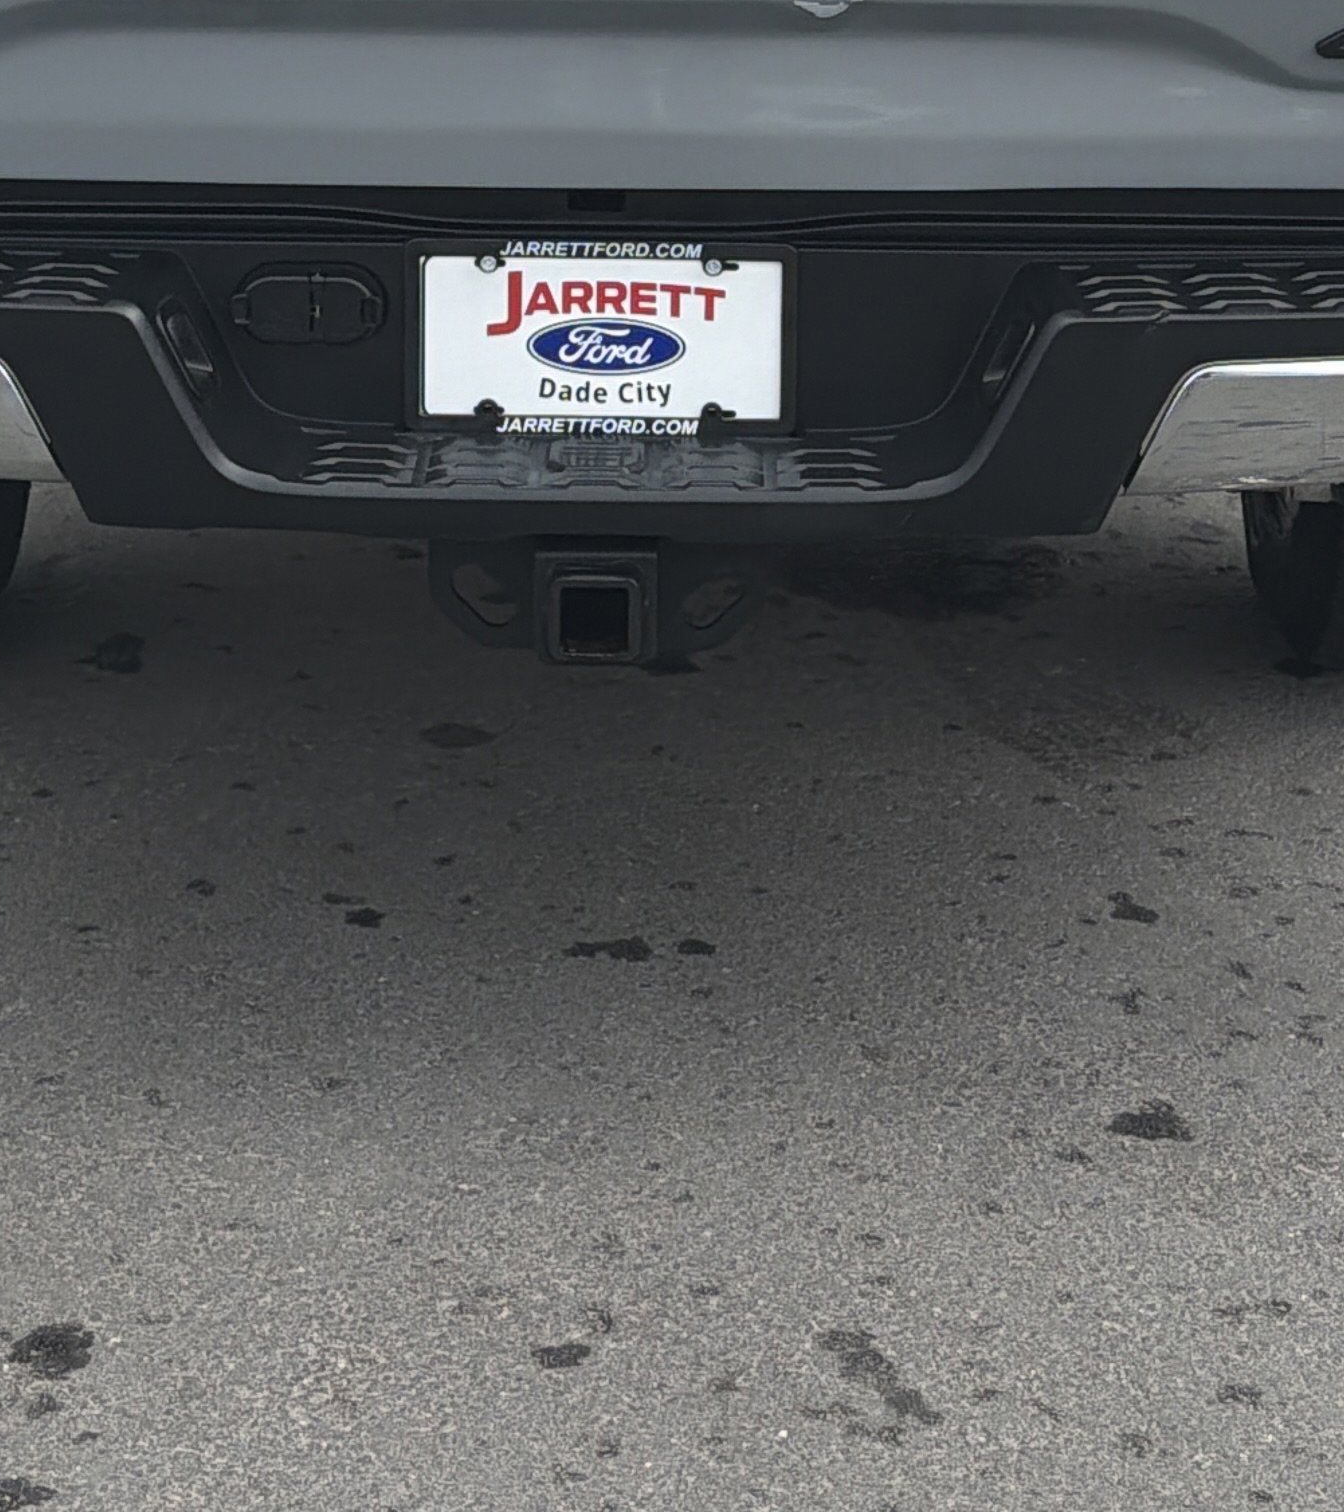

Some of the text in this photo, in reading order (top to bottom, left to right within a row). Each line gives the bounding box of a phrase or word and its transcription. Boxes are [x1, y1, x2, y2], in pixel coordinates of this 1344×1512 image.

[499, 240, 703, 260] JARRETTFORD.COM
[486, 270, 727, 337] JARRETT
[558, 325, 655, 366] Ford
[538, 376, 672, 408] Dade City
[495, 415, 700, 437] JARRETTFORD.COM
